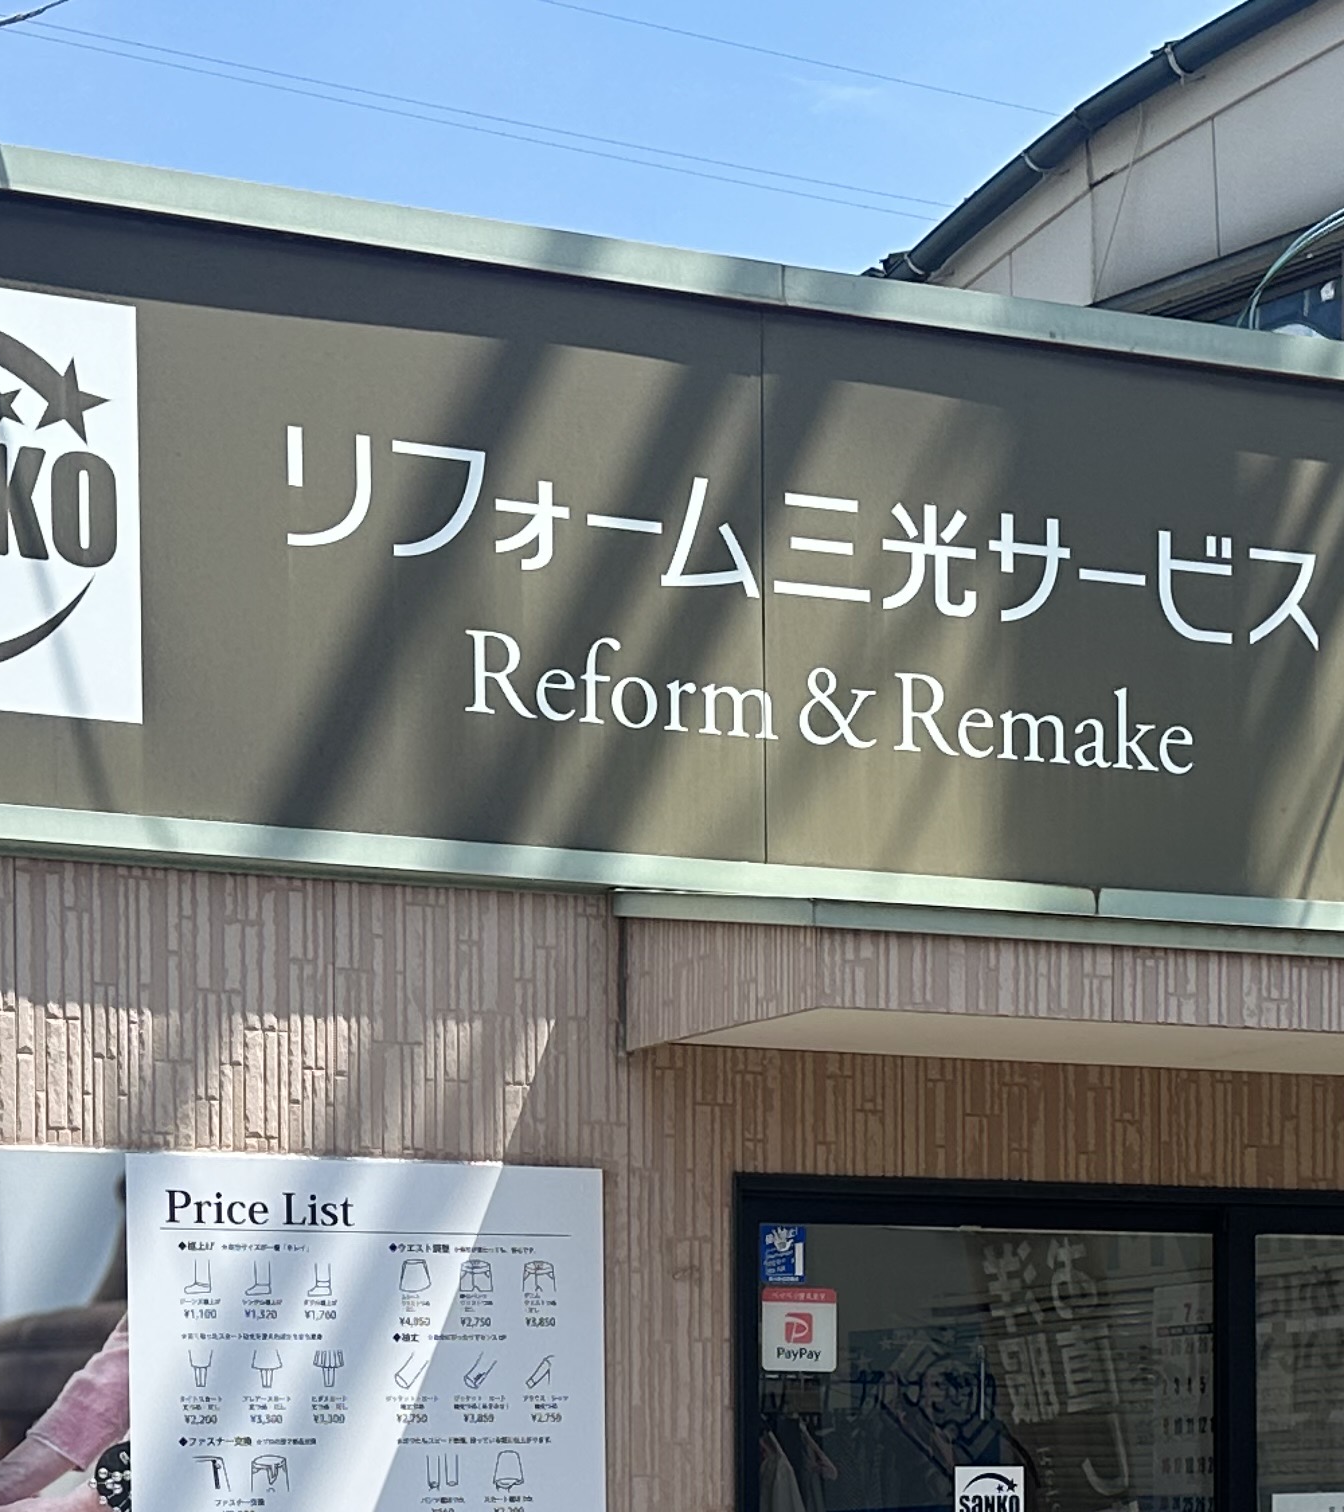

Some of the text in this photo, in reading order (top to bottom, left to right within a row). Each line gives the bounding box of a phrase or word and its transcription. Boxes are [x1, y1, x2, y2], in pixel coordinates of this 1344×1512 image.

[285, 426, 1320, 651] リフォーム三光サービス
[464, 628, 1195, 775] Reform & Remake
[165, 1188, 356, 1227] Price List
[776, 1347, 821, 1362] PayPay
